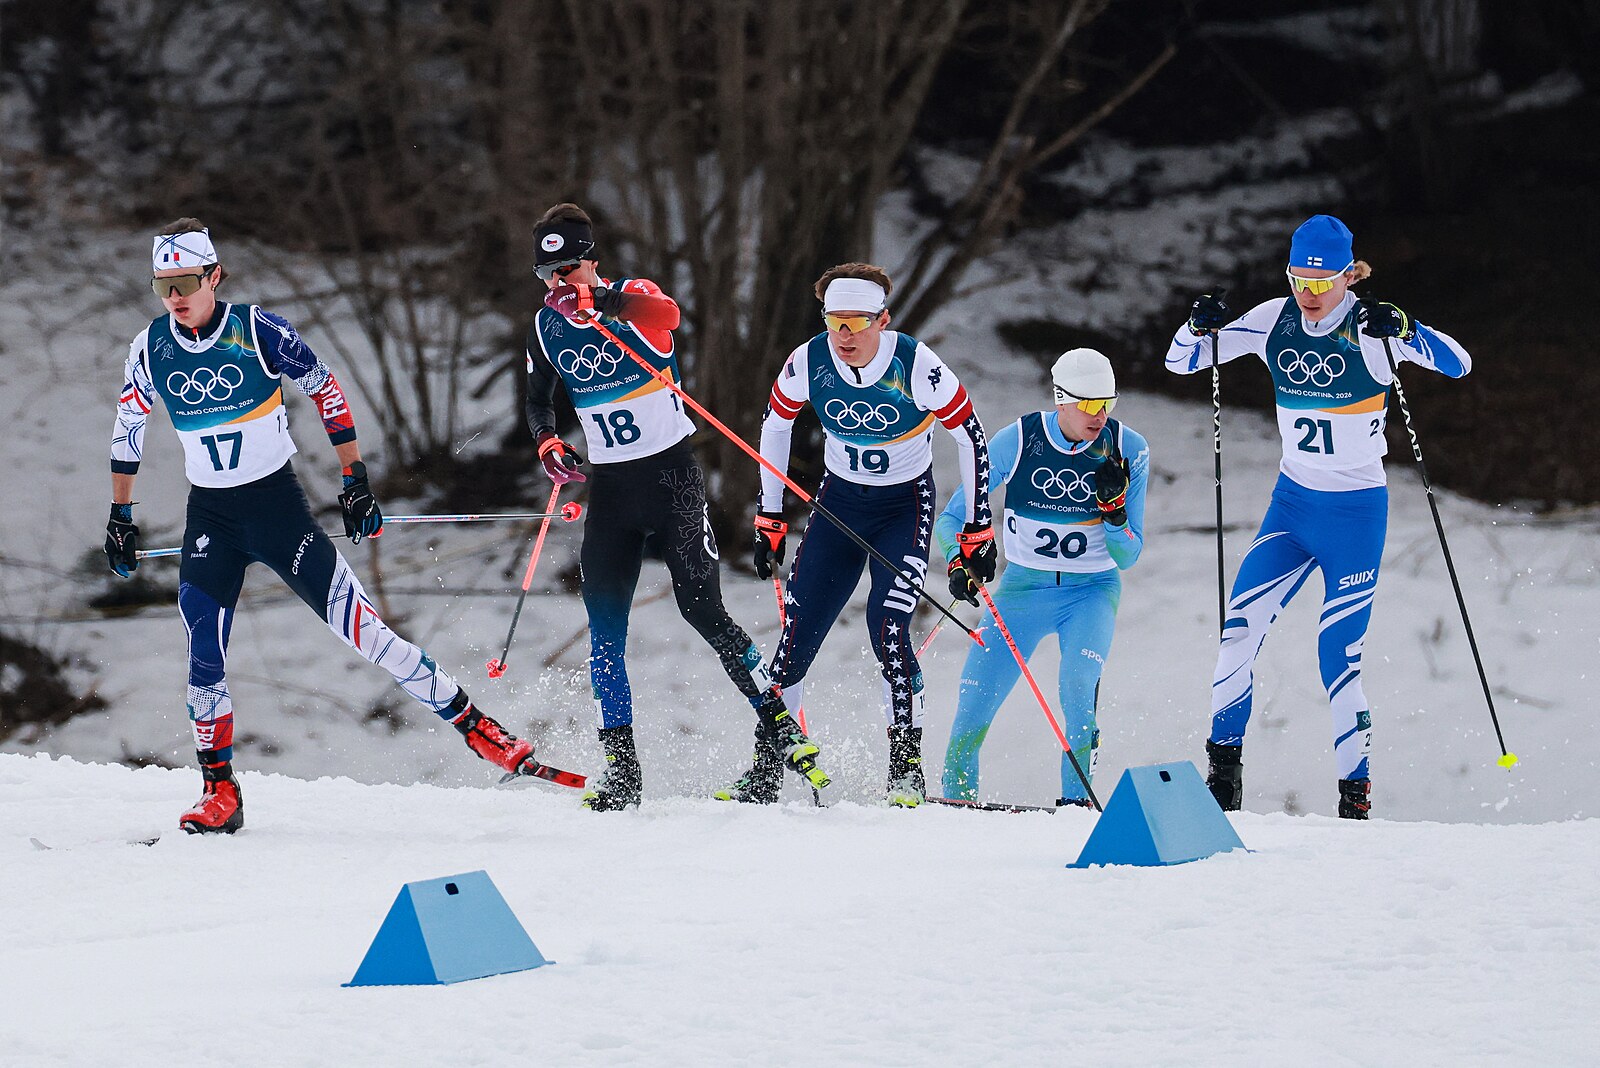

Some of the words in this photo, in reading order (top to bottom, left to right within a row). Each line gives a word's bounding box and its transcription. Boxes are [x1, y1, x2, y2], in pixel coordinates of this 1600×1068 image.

[593, 380, 624, 391] CORTINA
[623, 373, 640, 383] 2026
[1278, 385, 1302, 396] MILANO
[1302, 390, 1334, 399] CORTINA
[1335, 391, 1353, 399] 2026
[202, 405, 238, 414] CORTINA
[238, 398, 254, 408] 2026
[592, 409, 641, 448] 18
[1294, 416, 1335, 455] 21
[200, 430, 243, 472] 17
[844, 444, 890, 475] 19
[1027, 500, 1056, 510] MILANO
[1057, 505, 1088, 514] CORTINA
[291, 538, 310, 576] CRAFT
[1033, 528, 1088, 559] 20
[882, 555, 928, 614] USA
[1338, 568, 1375, 591] SWIX
